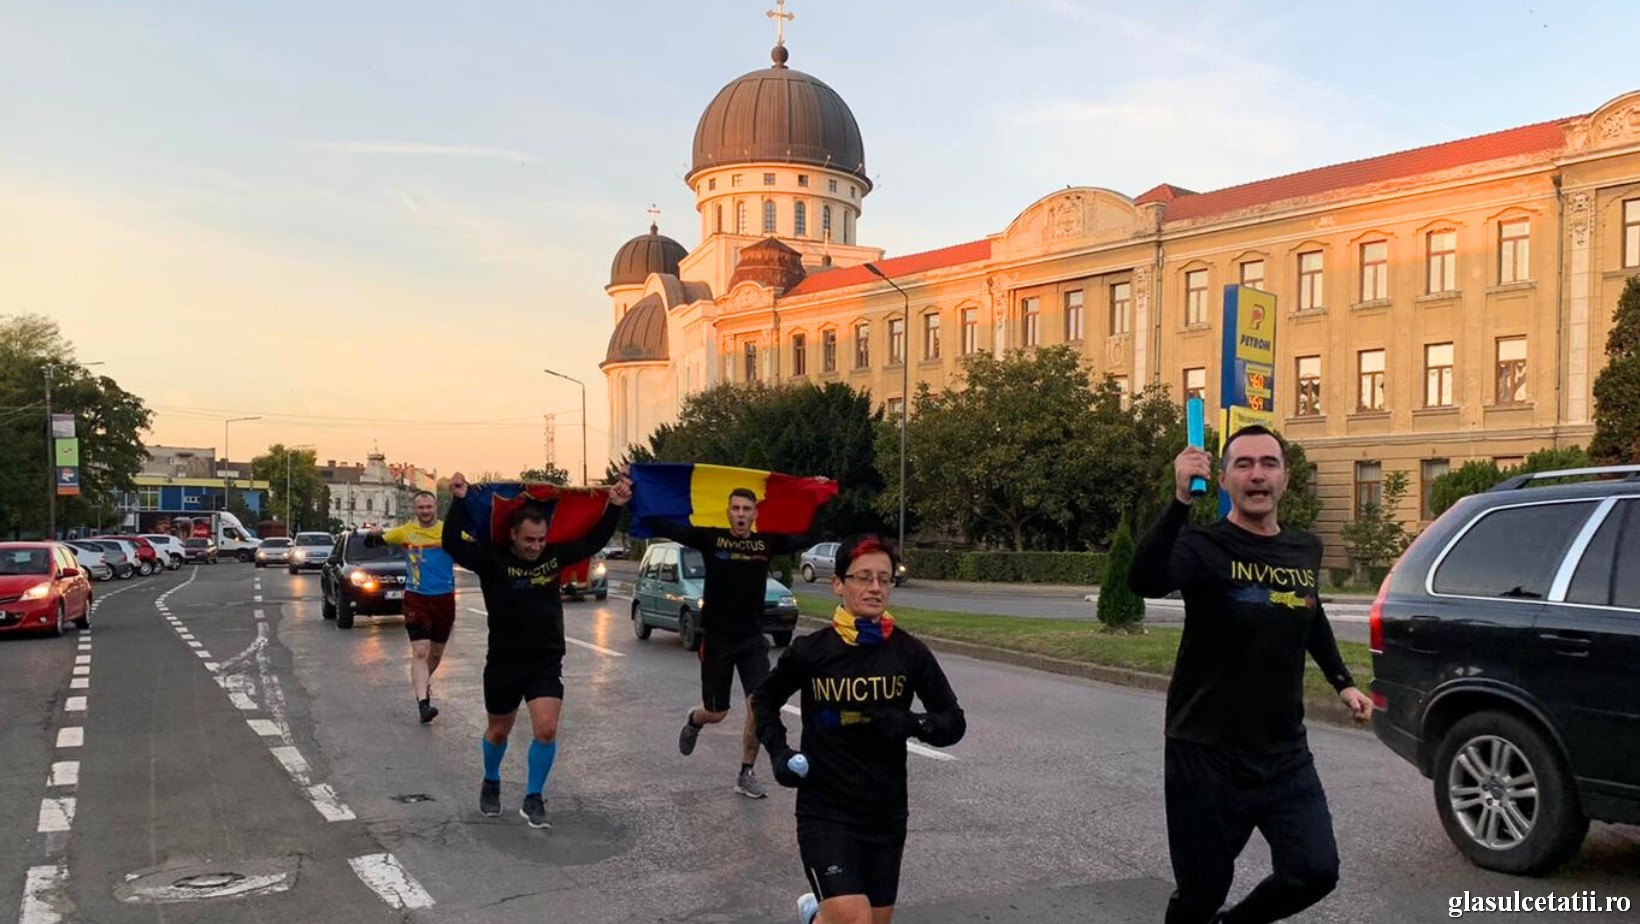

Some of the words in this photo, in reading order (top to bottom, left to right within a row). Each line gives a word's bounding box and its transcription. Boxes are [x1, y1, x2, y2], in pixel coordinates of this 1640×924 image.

[1240, 334, 1271, 352] PETROM
[716, 537, 767, 552] INVICTUS
[1229, 561, 1315, 588] INVICTUS
[812, 675, 907, 702] INVICTUS
